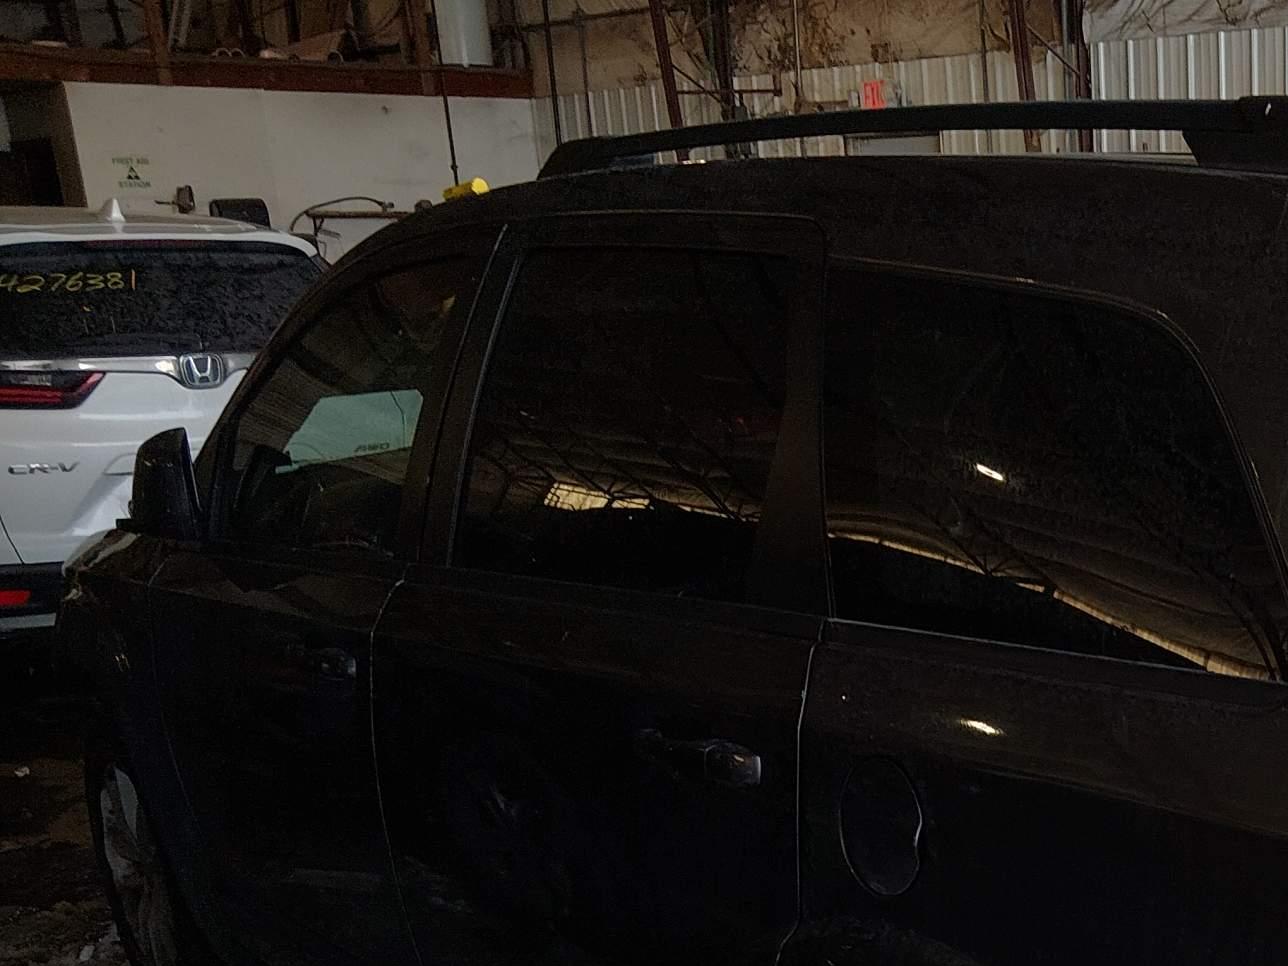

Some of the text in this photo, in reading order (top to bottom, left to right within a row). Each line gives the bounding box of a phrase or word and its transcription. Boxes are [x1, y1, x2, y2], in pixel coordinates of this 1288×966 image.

[112, 157, 133, 166] FIRST
[118, 180, 151, 188] STATION
[8, 461, 80, 475] CR-V
